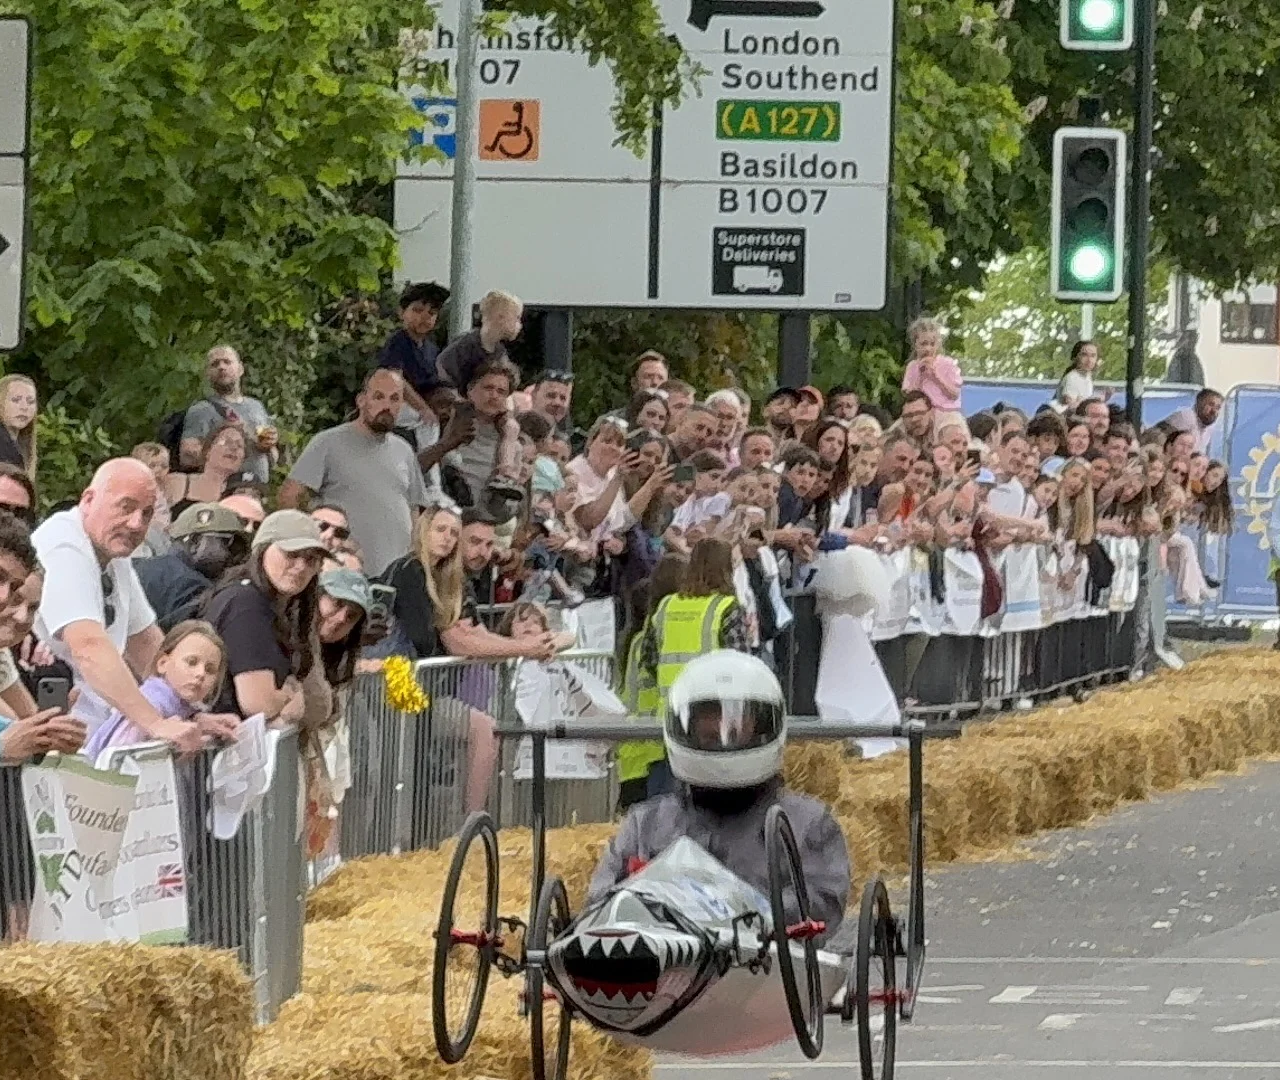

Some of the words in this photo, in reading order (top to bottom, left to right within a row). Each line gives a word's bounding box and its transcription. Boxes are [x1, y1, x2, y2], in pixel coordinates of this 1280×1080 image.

[723, 28, 840, 56] London
[721, 63, 879, 91] Southend
[720, 151, 858, 179] Basildon
[719, 188, 829, 215] B1007
[718, 231, 802, 247] Superstore
[721, 247, 797, 263] Deliveries
